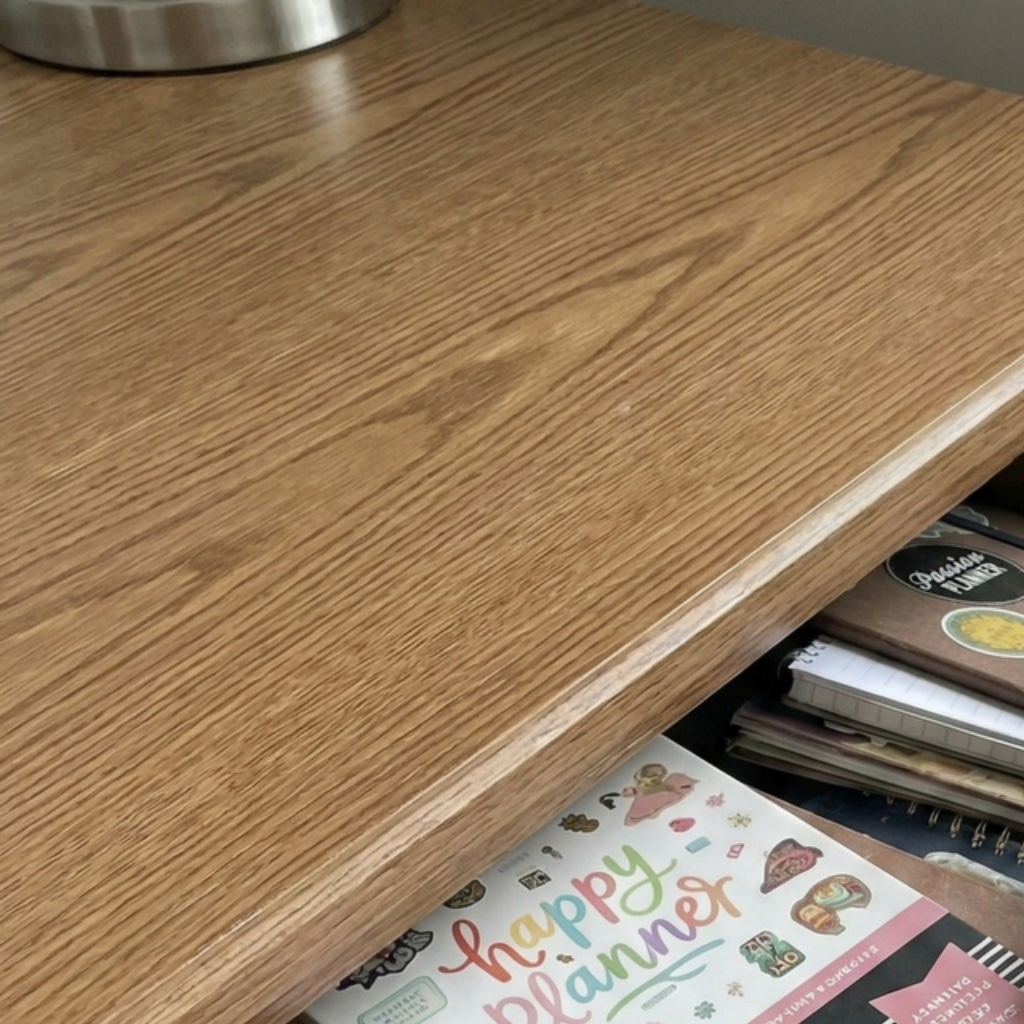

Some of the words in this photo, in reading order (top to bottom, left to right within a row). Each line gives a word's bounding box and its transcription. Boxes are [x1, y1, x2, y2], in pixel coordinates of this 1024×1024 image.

[908, 551, 984, 590] Passion
[940, 562, 1008, 594] PLANNER
[437, 844, 678, 983] happy
